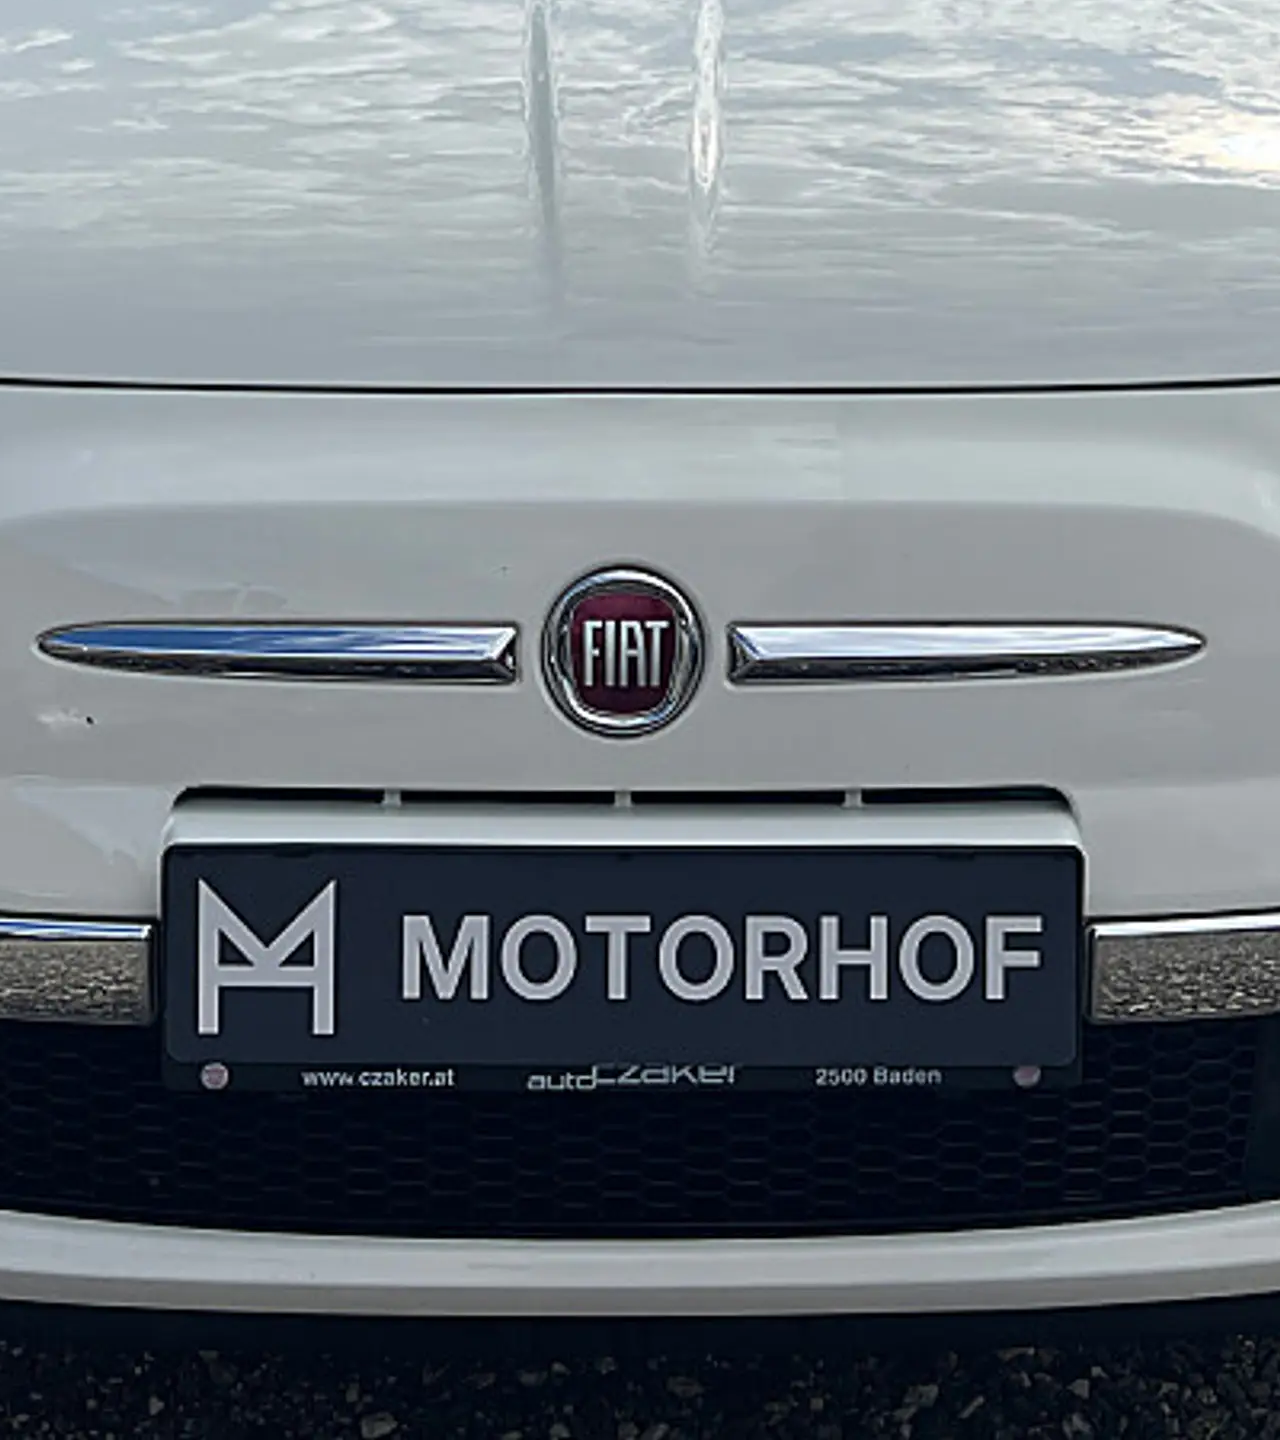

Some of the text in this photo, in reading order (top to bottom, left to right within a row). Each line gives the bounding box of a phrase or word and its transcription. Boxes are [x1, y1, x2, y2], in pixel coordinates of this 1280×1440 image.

[582, 619, 670, 687] FIAT
[300, 1067, 456, 1087] www.czaker.at
[814, 1067, 869, 1087] 2500
[872, 1065, 943, 1086] Baden
